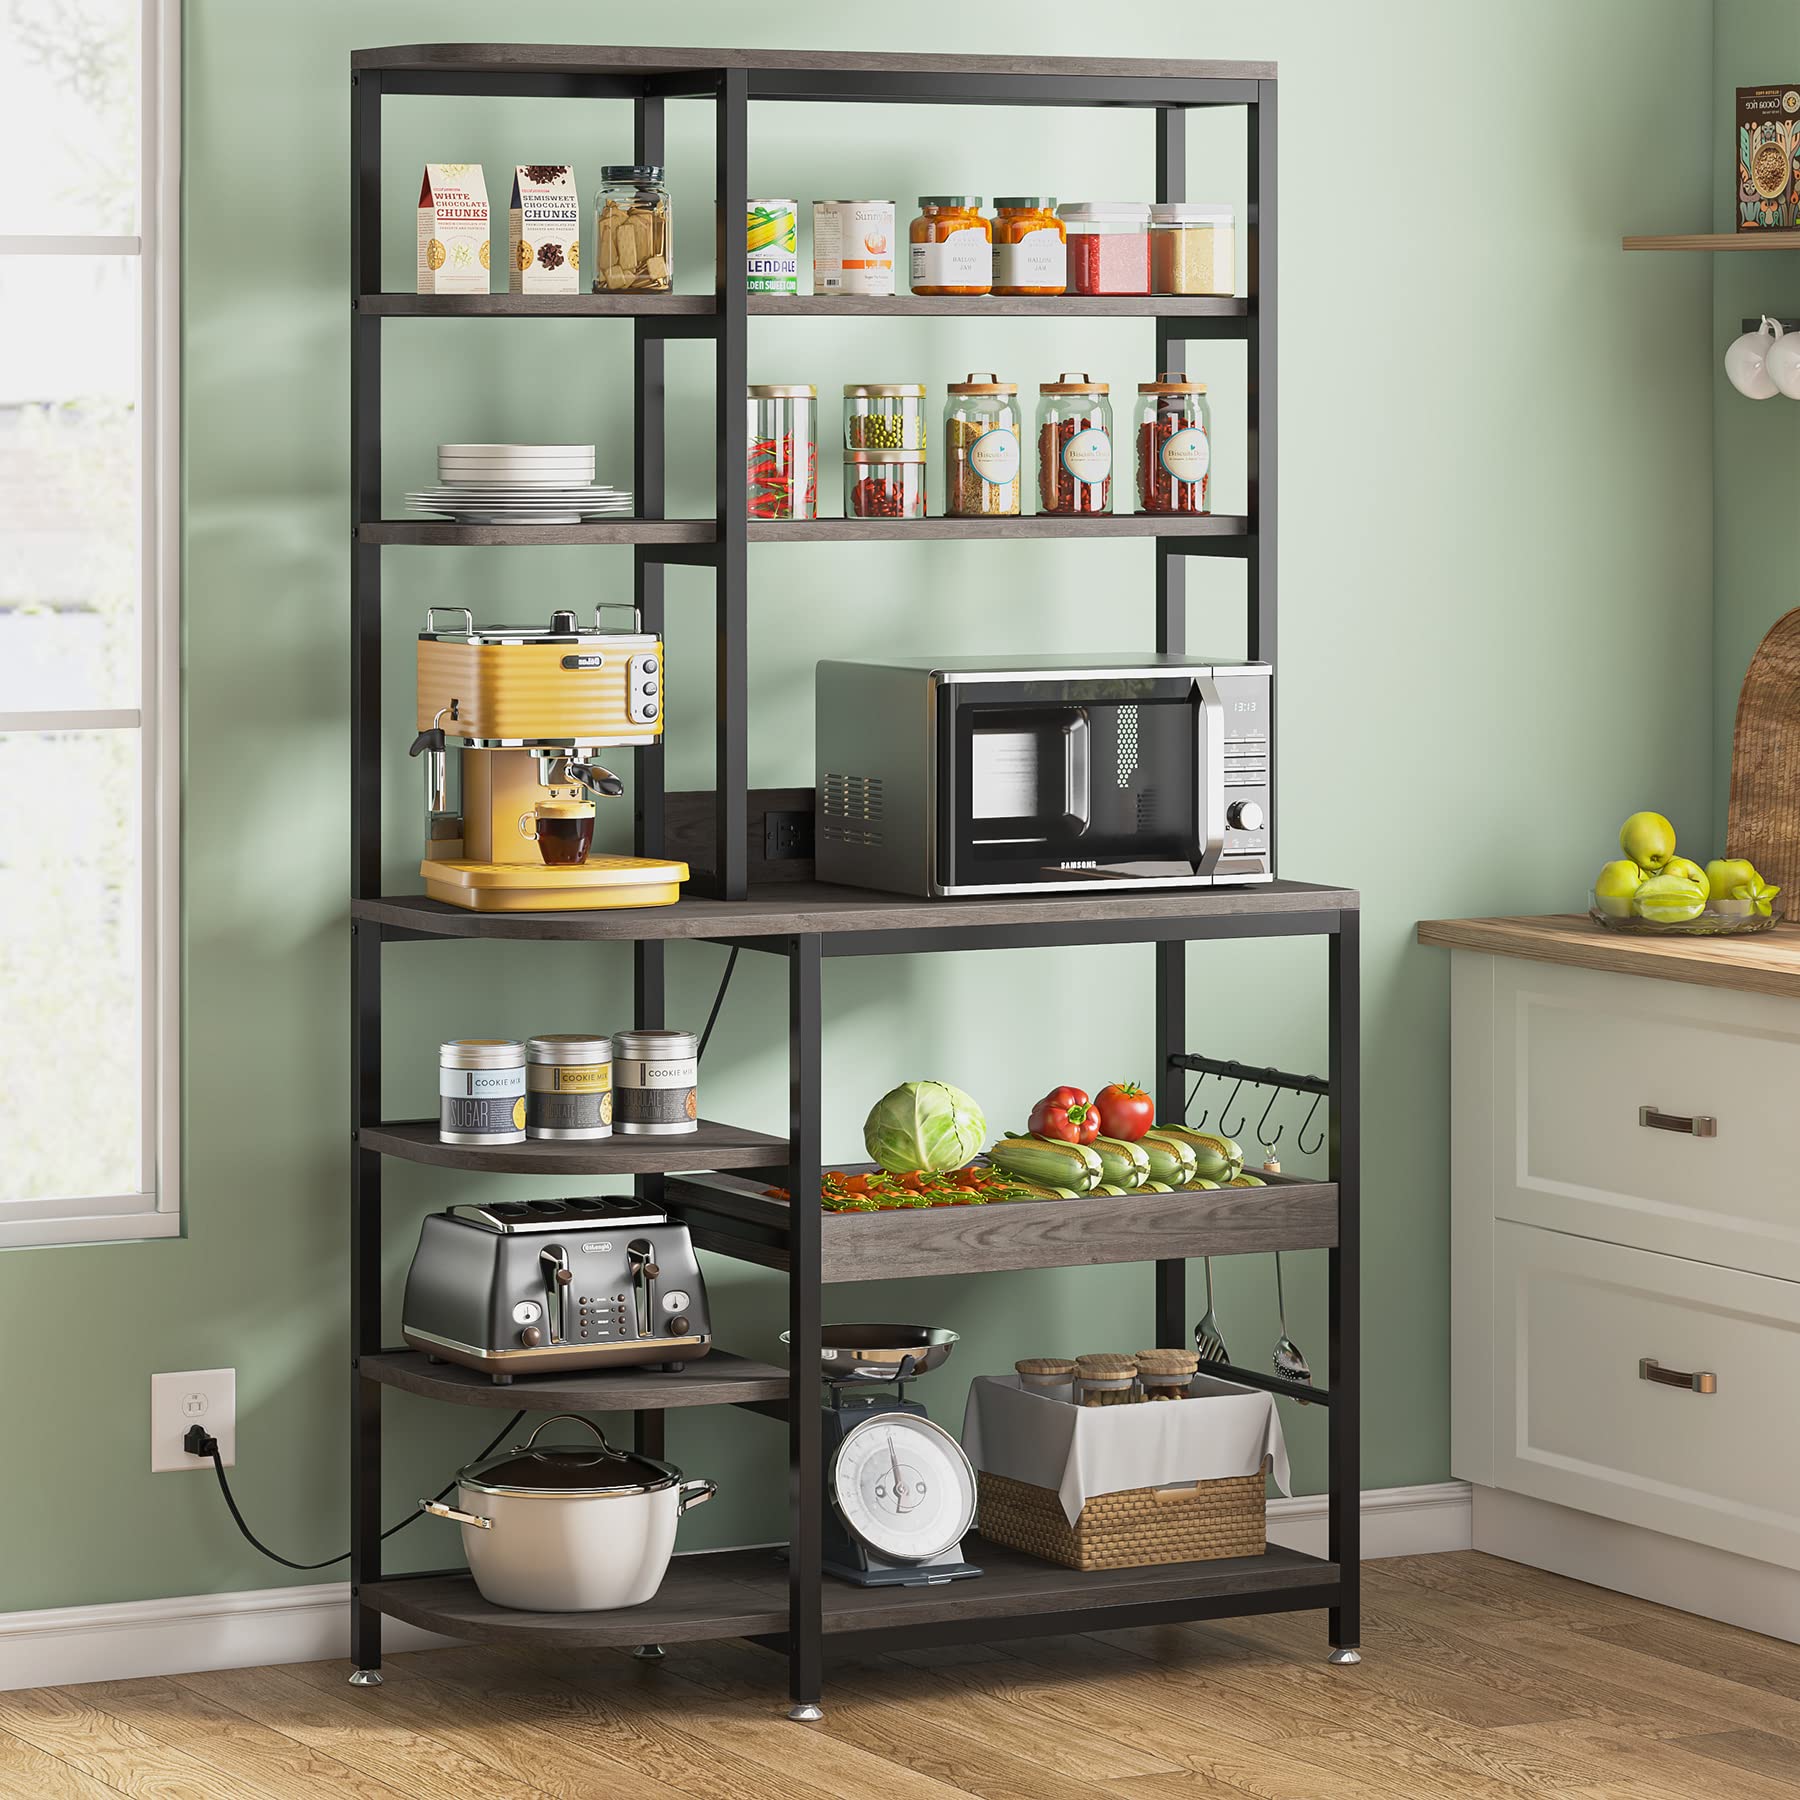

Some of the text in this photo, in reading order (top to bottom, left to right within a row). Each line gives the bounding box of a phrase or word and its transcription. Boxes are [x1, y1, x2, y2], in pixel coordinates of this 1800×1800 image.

[437, 209, 488, 218] CHUNKS
[524, 209, 577, 219] CHUNKS
[748, 260, 795, 273] LENDALE
[747, 280, 764, 290] LDEN
[1061, 860, 1097, 870] SAMSUNG
[562, 1073, 608, 1082] COOKIE MIX
[648, 1070, 681, 1078] COOKIE
[475, 1079, 508, 1087] COOKIE
[450, 1099, 488, 1128] SUGAR
